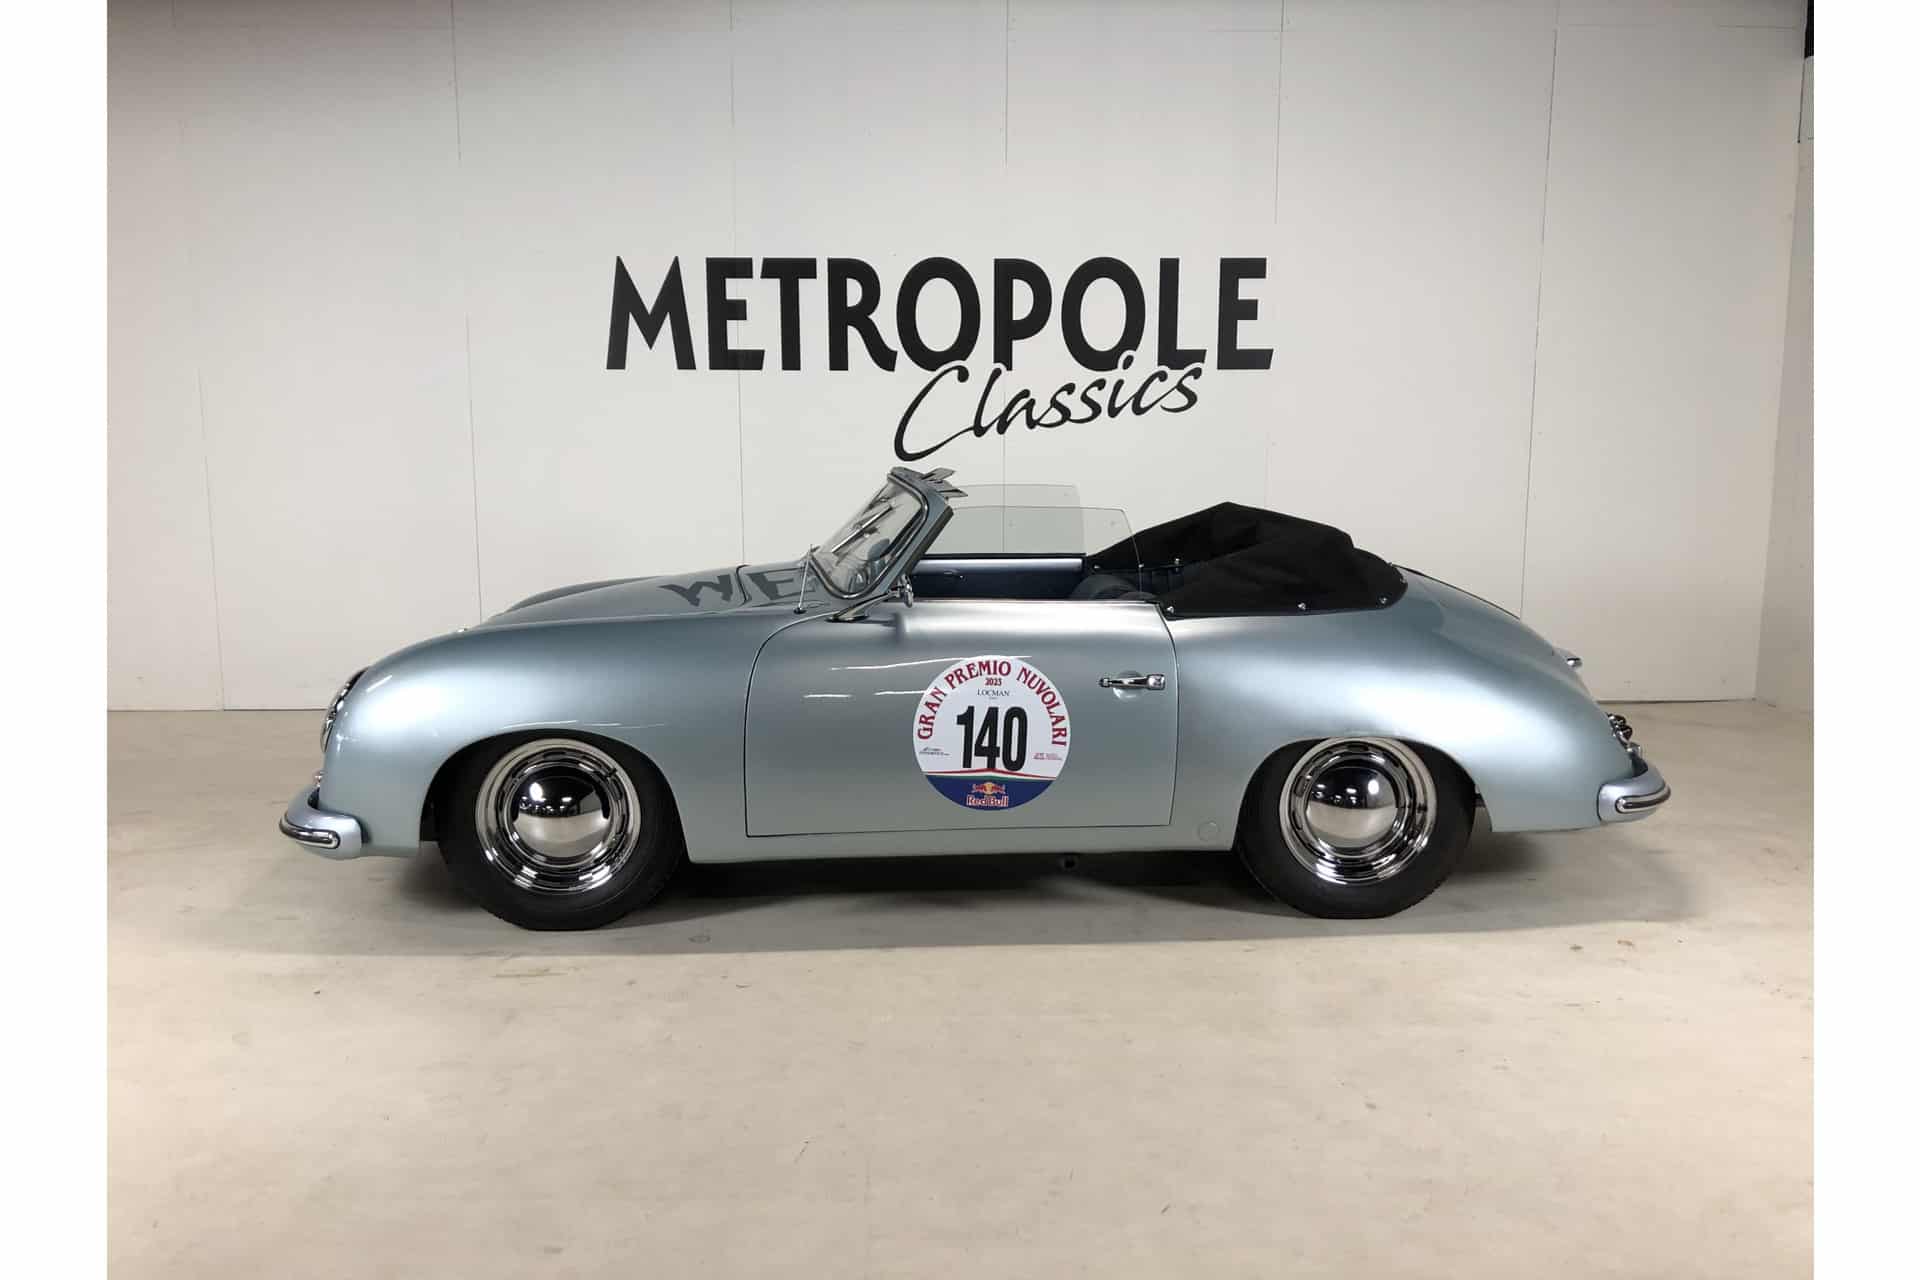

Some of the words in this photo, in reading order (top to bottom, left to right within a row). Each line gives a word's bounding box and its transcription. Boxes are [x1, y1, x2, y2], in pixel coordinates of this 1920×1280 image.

[606, 256, 1274, 371] METROPOLE
[893, 353, 1203, 462] Classics
[917, 686, 948, 740] GRAN
[944, 660, 1012, 690] PREMIO
[1016, 667, 1067, 746] NUVOLARI
[977, 688, 1011, 697] LOCMAN
[956, 705, 1028, 772] 140
